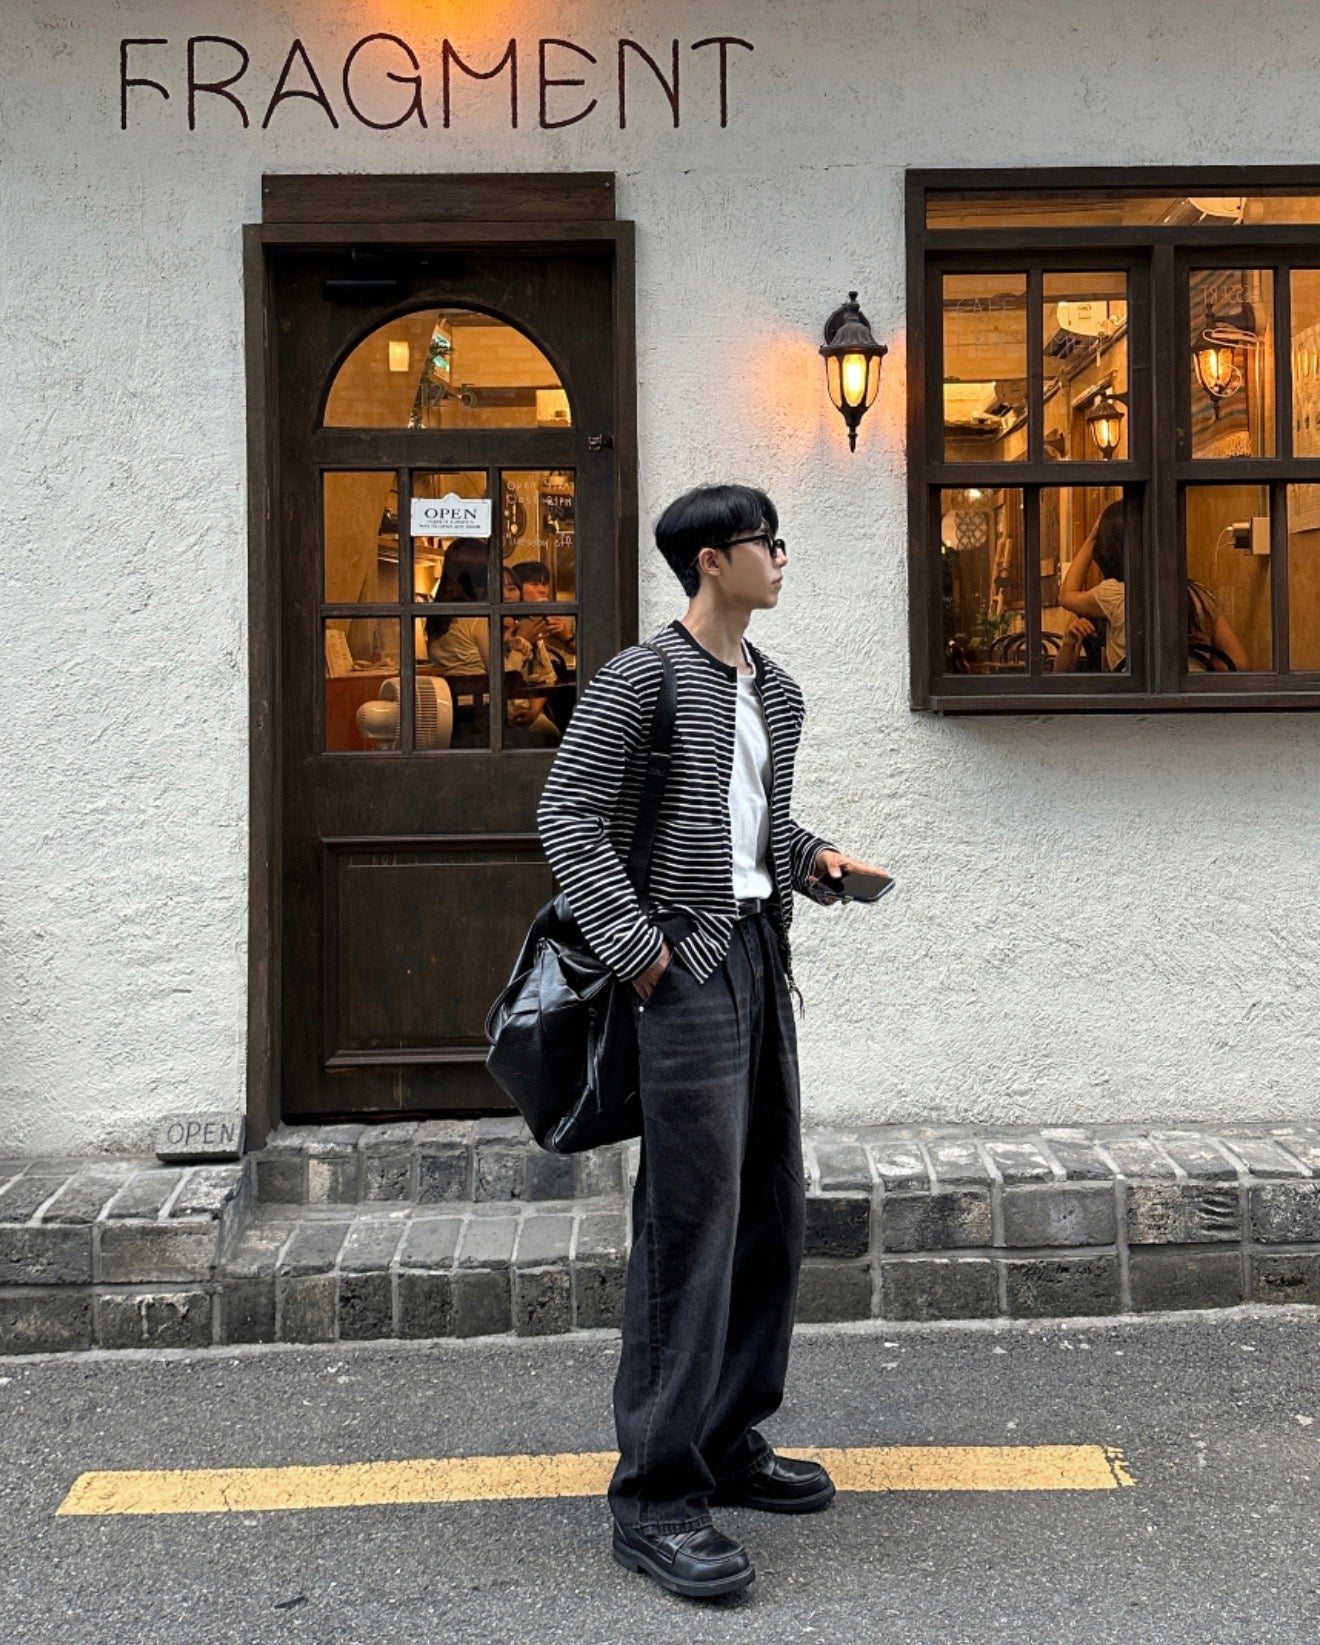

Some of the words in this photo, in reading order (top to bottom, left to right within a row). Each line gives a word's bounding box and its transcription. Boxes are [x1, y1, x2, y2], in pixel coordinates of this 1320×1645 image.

[120, 33, 754, 130] FRAGMENT
[424, 507, 477, 519] OPEN
[167, 1121, 235, 1145] OPEN
